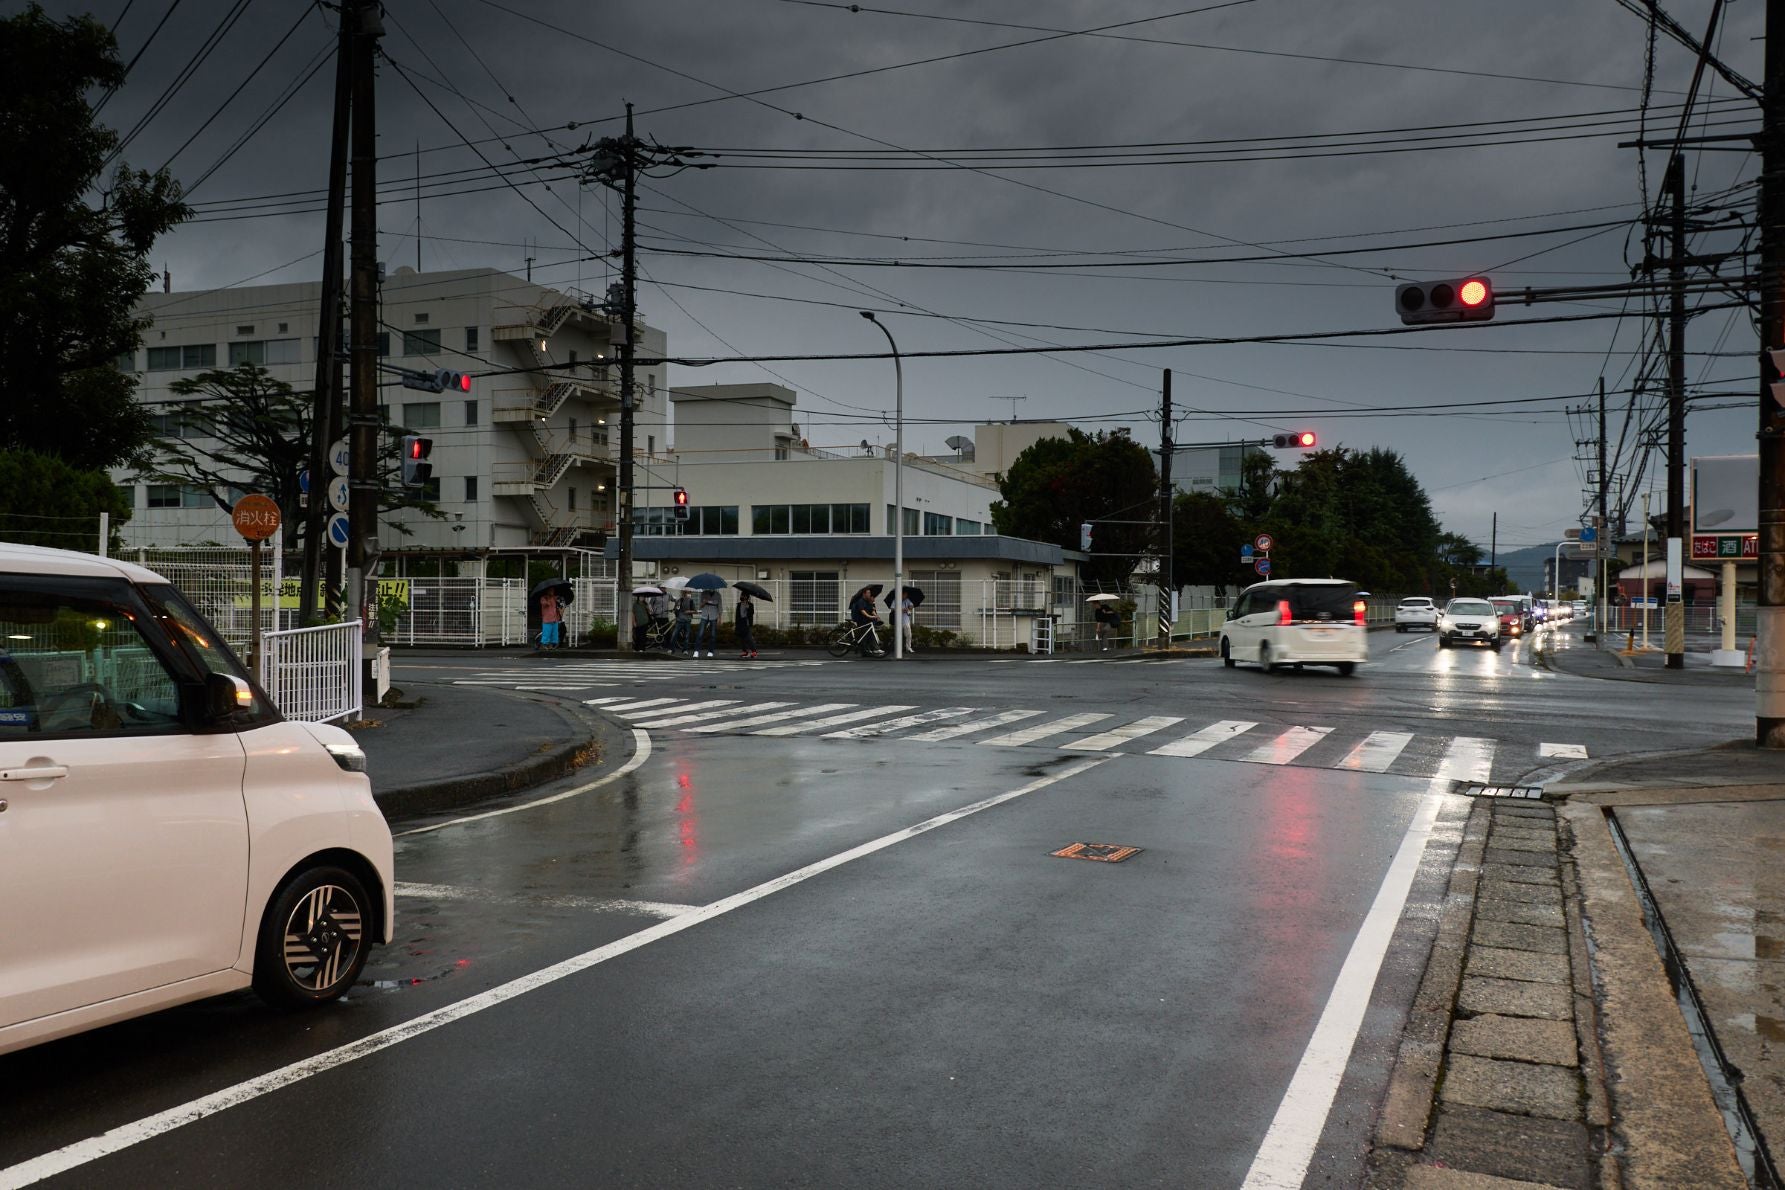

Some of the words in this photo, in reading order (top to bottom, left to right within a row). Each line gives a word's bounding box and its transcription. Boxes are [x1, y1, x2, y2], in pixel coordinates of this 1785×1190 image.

[335, 450, 350, 466] 40
[236, 510, 279, 526] 消火栓
[1694, 541, 1716, 554] たばこ
[1722, 541, 1737, 554] 酒
[1744, 541, 1759, 553] AT
